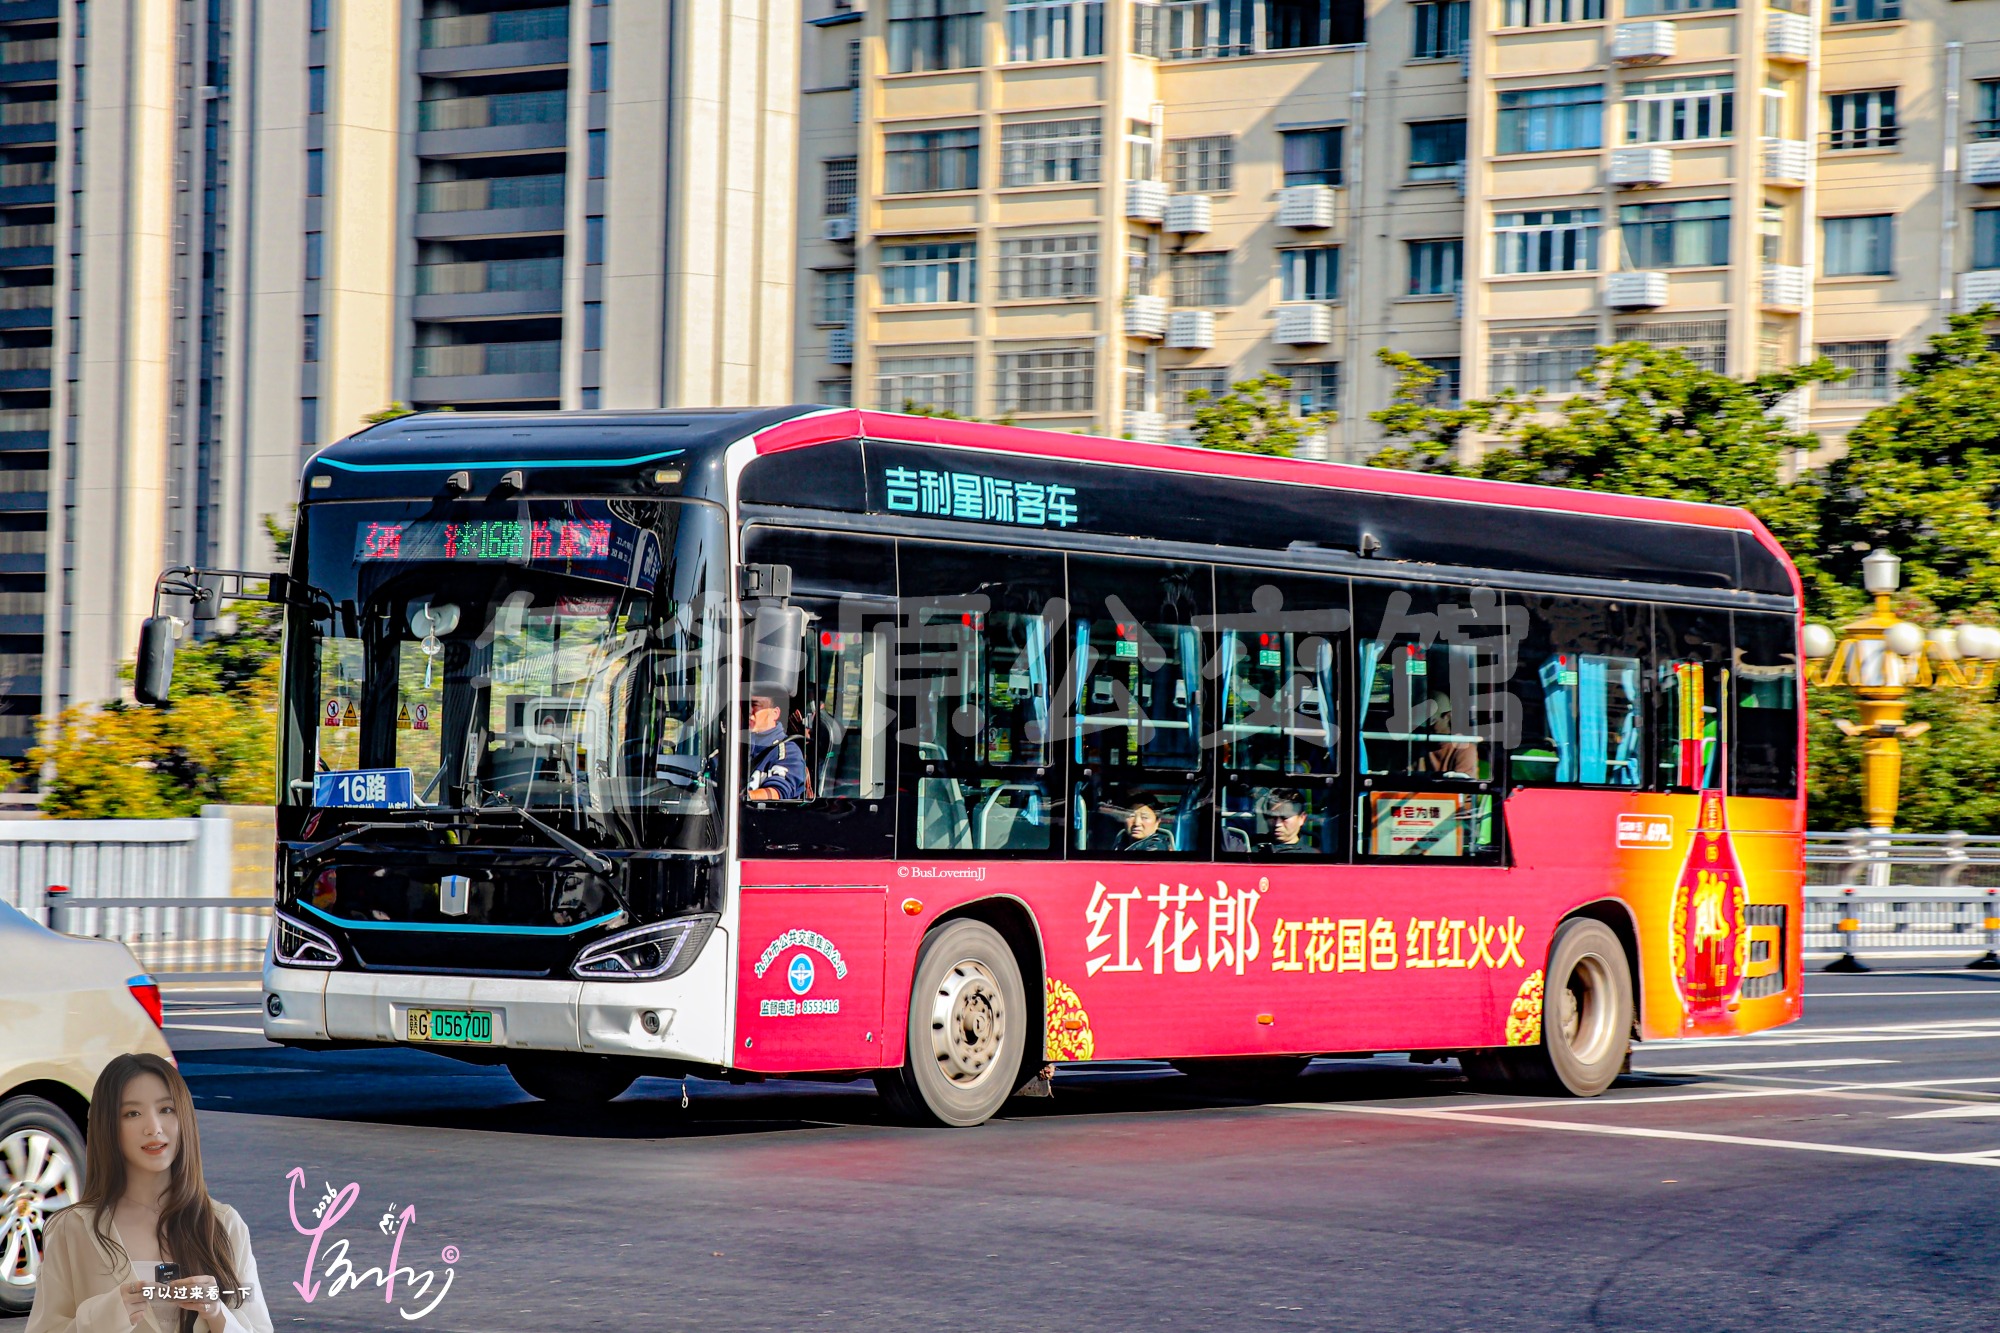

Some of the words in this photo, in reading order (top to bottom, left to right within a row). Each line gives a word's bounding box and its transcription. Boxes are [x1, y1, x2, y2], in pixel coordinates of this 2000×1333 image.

[885, 466, 1078, 527] 吉利星际客车
[338, 774, 386, 803] 16路
[755, 929, 848, 980] 九江市公共交通集团公司
[1085, 880, 1261, 977] 红花郎
[1272, 916, 1399, 974] 红花国色
[1405, 916, 1526, 970] 红红火火
